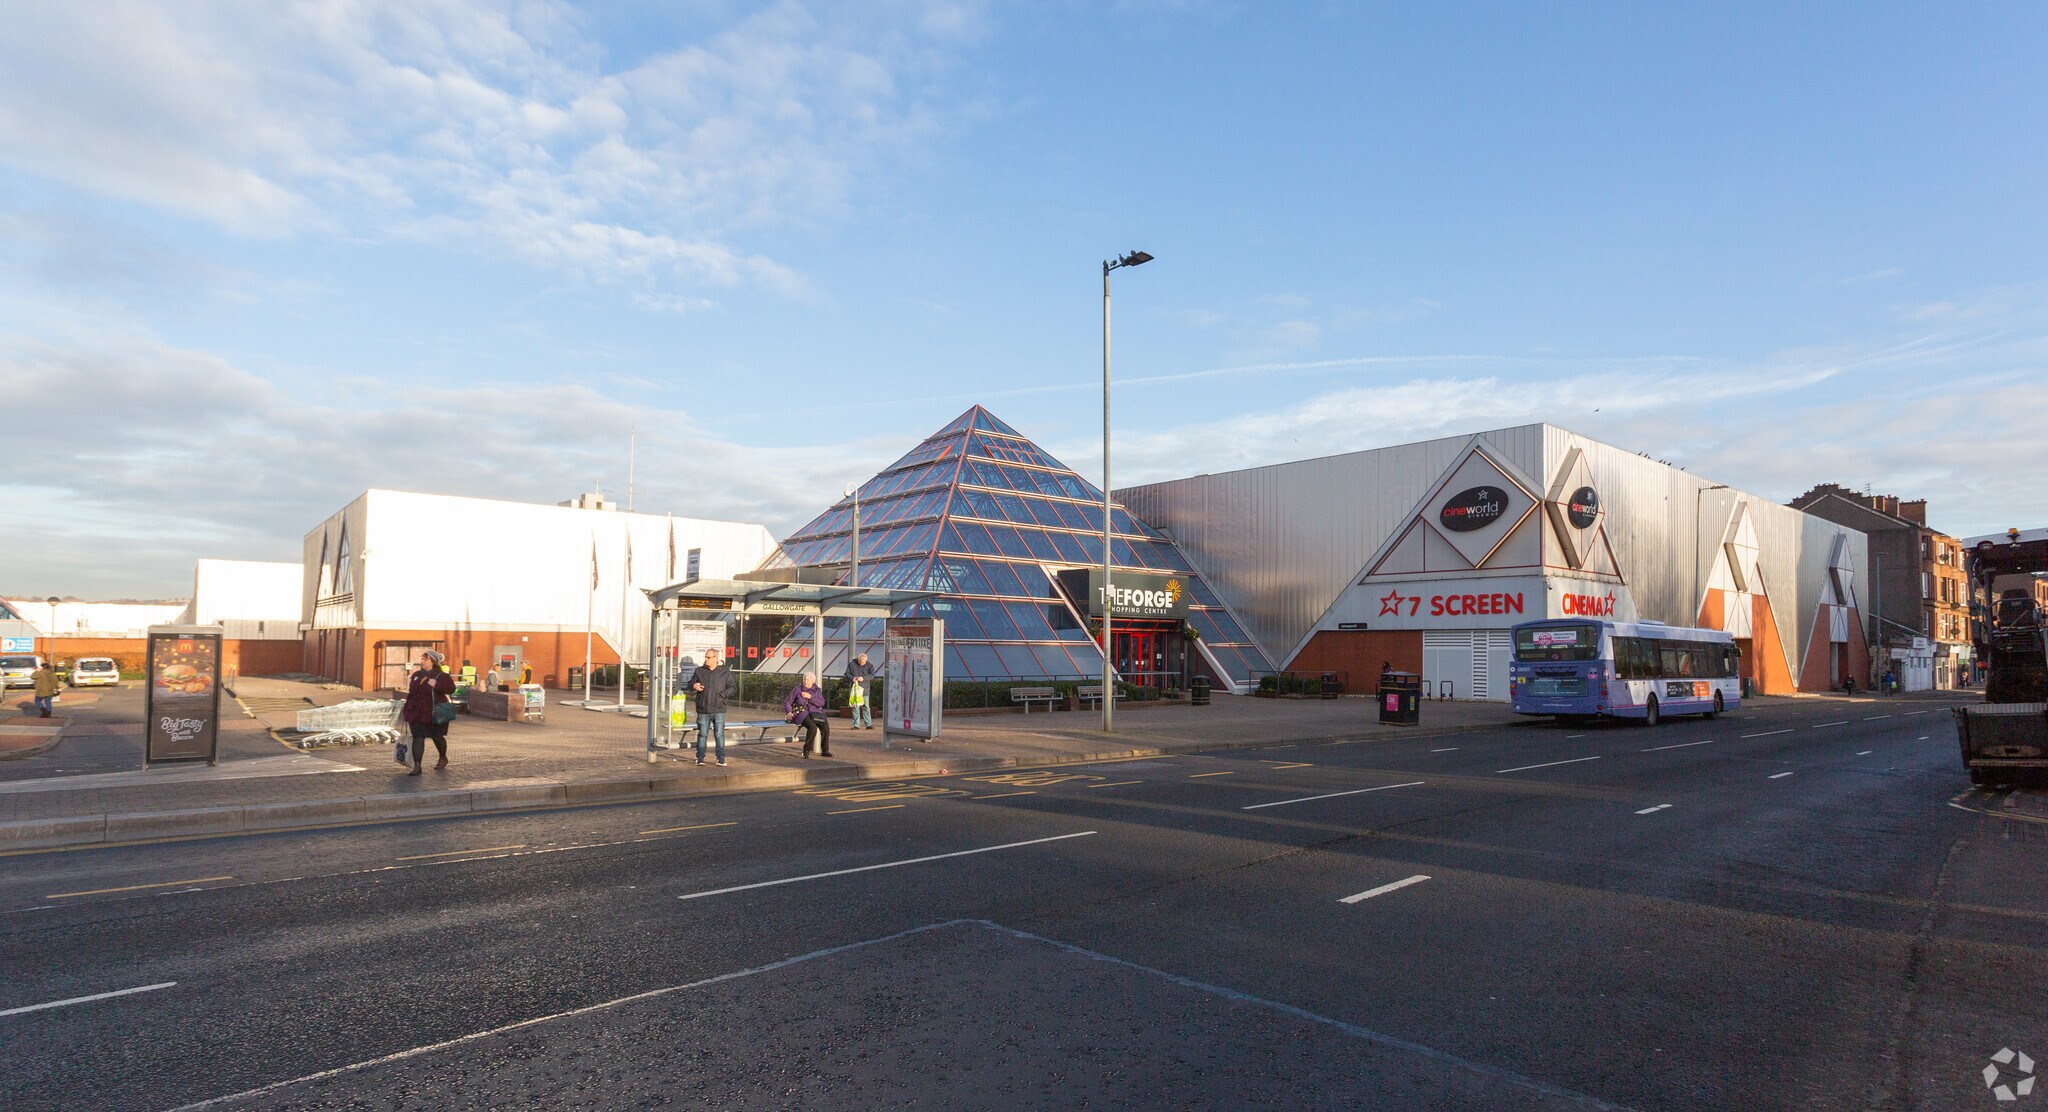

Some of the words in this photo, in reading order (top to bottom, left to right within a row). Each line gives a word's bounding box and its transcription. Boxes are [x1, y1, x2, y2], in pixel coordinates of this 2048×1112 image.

[1443, 501, 1499, 517] cineworld
[1572, 502, 1597, 515] cineworld
[762, 603, 806, 612] GALLOWGATE
[1111, 606, 1140, 614] HOPPING
[1408, 596, 1422, 616] 7
[1430, 592, 1523, 617] SCREEN
[1562, 593, 1603, 617] CINEMA
[160, 716, 180, 733] Big
[176, 718, 204, 732] Tasty
[171, 732, 194, 742] Bacon
